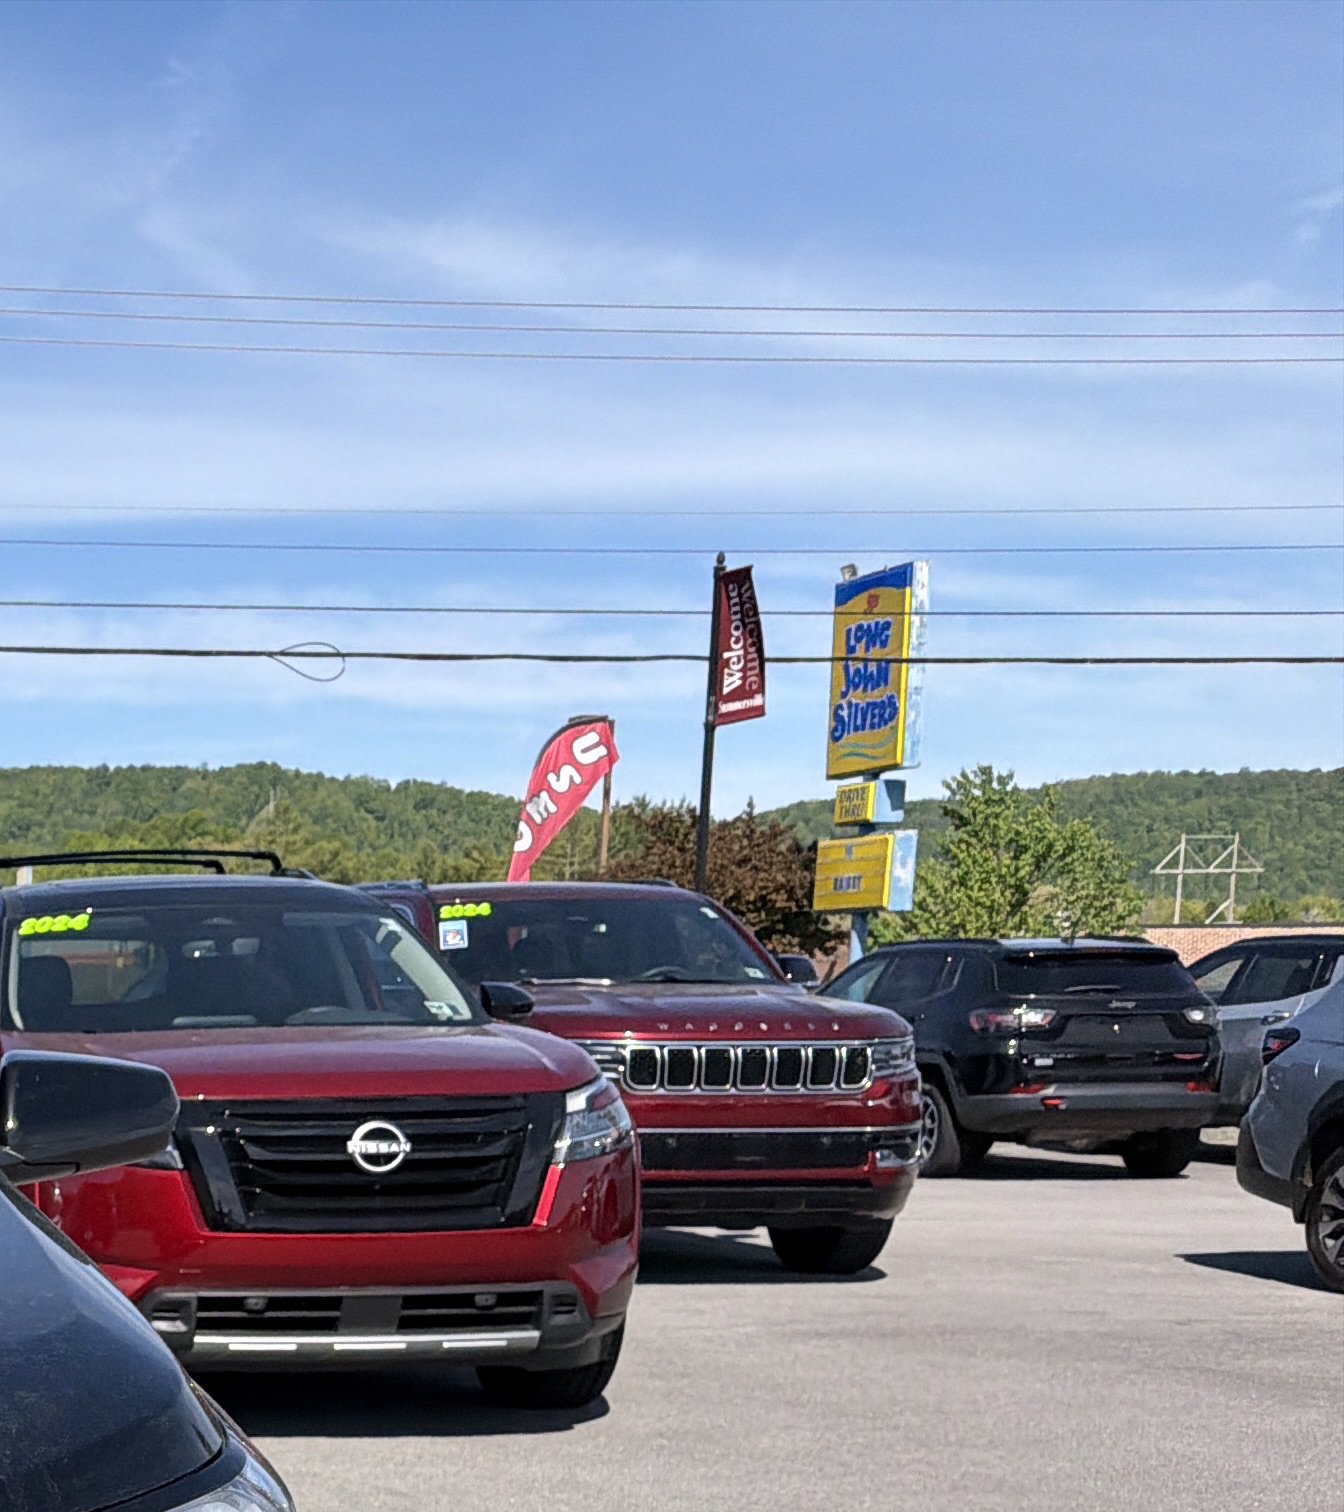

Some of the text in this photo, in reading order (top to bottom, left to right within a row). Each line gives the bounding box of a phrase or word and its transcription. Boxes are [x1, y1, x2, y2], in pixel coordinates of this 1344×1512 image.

[723, 582, 745, 696] Welcome
[845, 619, 892, 656] LONG
[840, 658, 892, 700] JOHN
[18, 913, 90, 936] 2024
[347, 1140, 412, 1154] NISSAN
